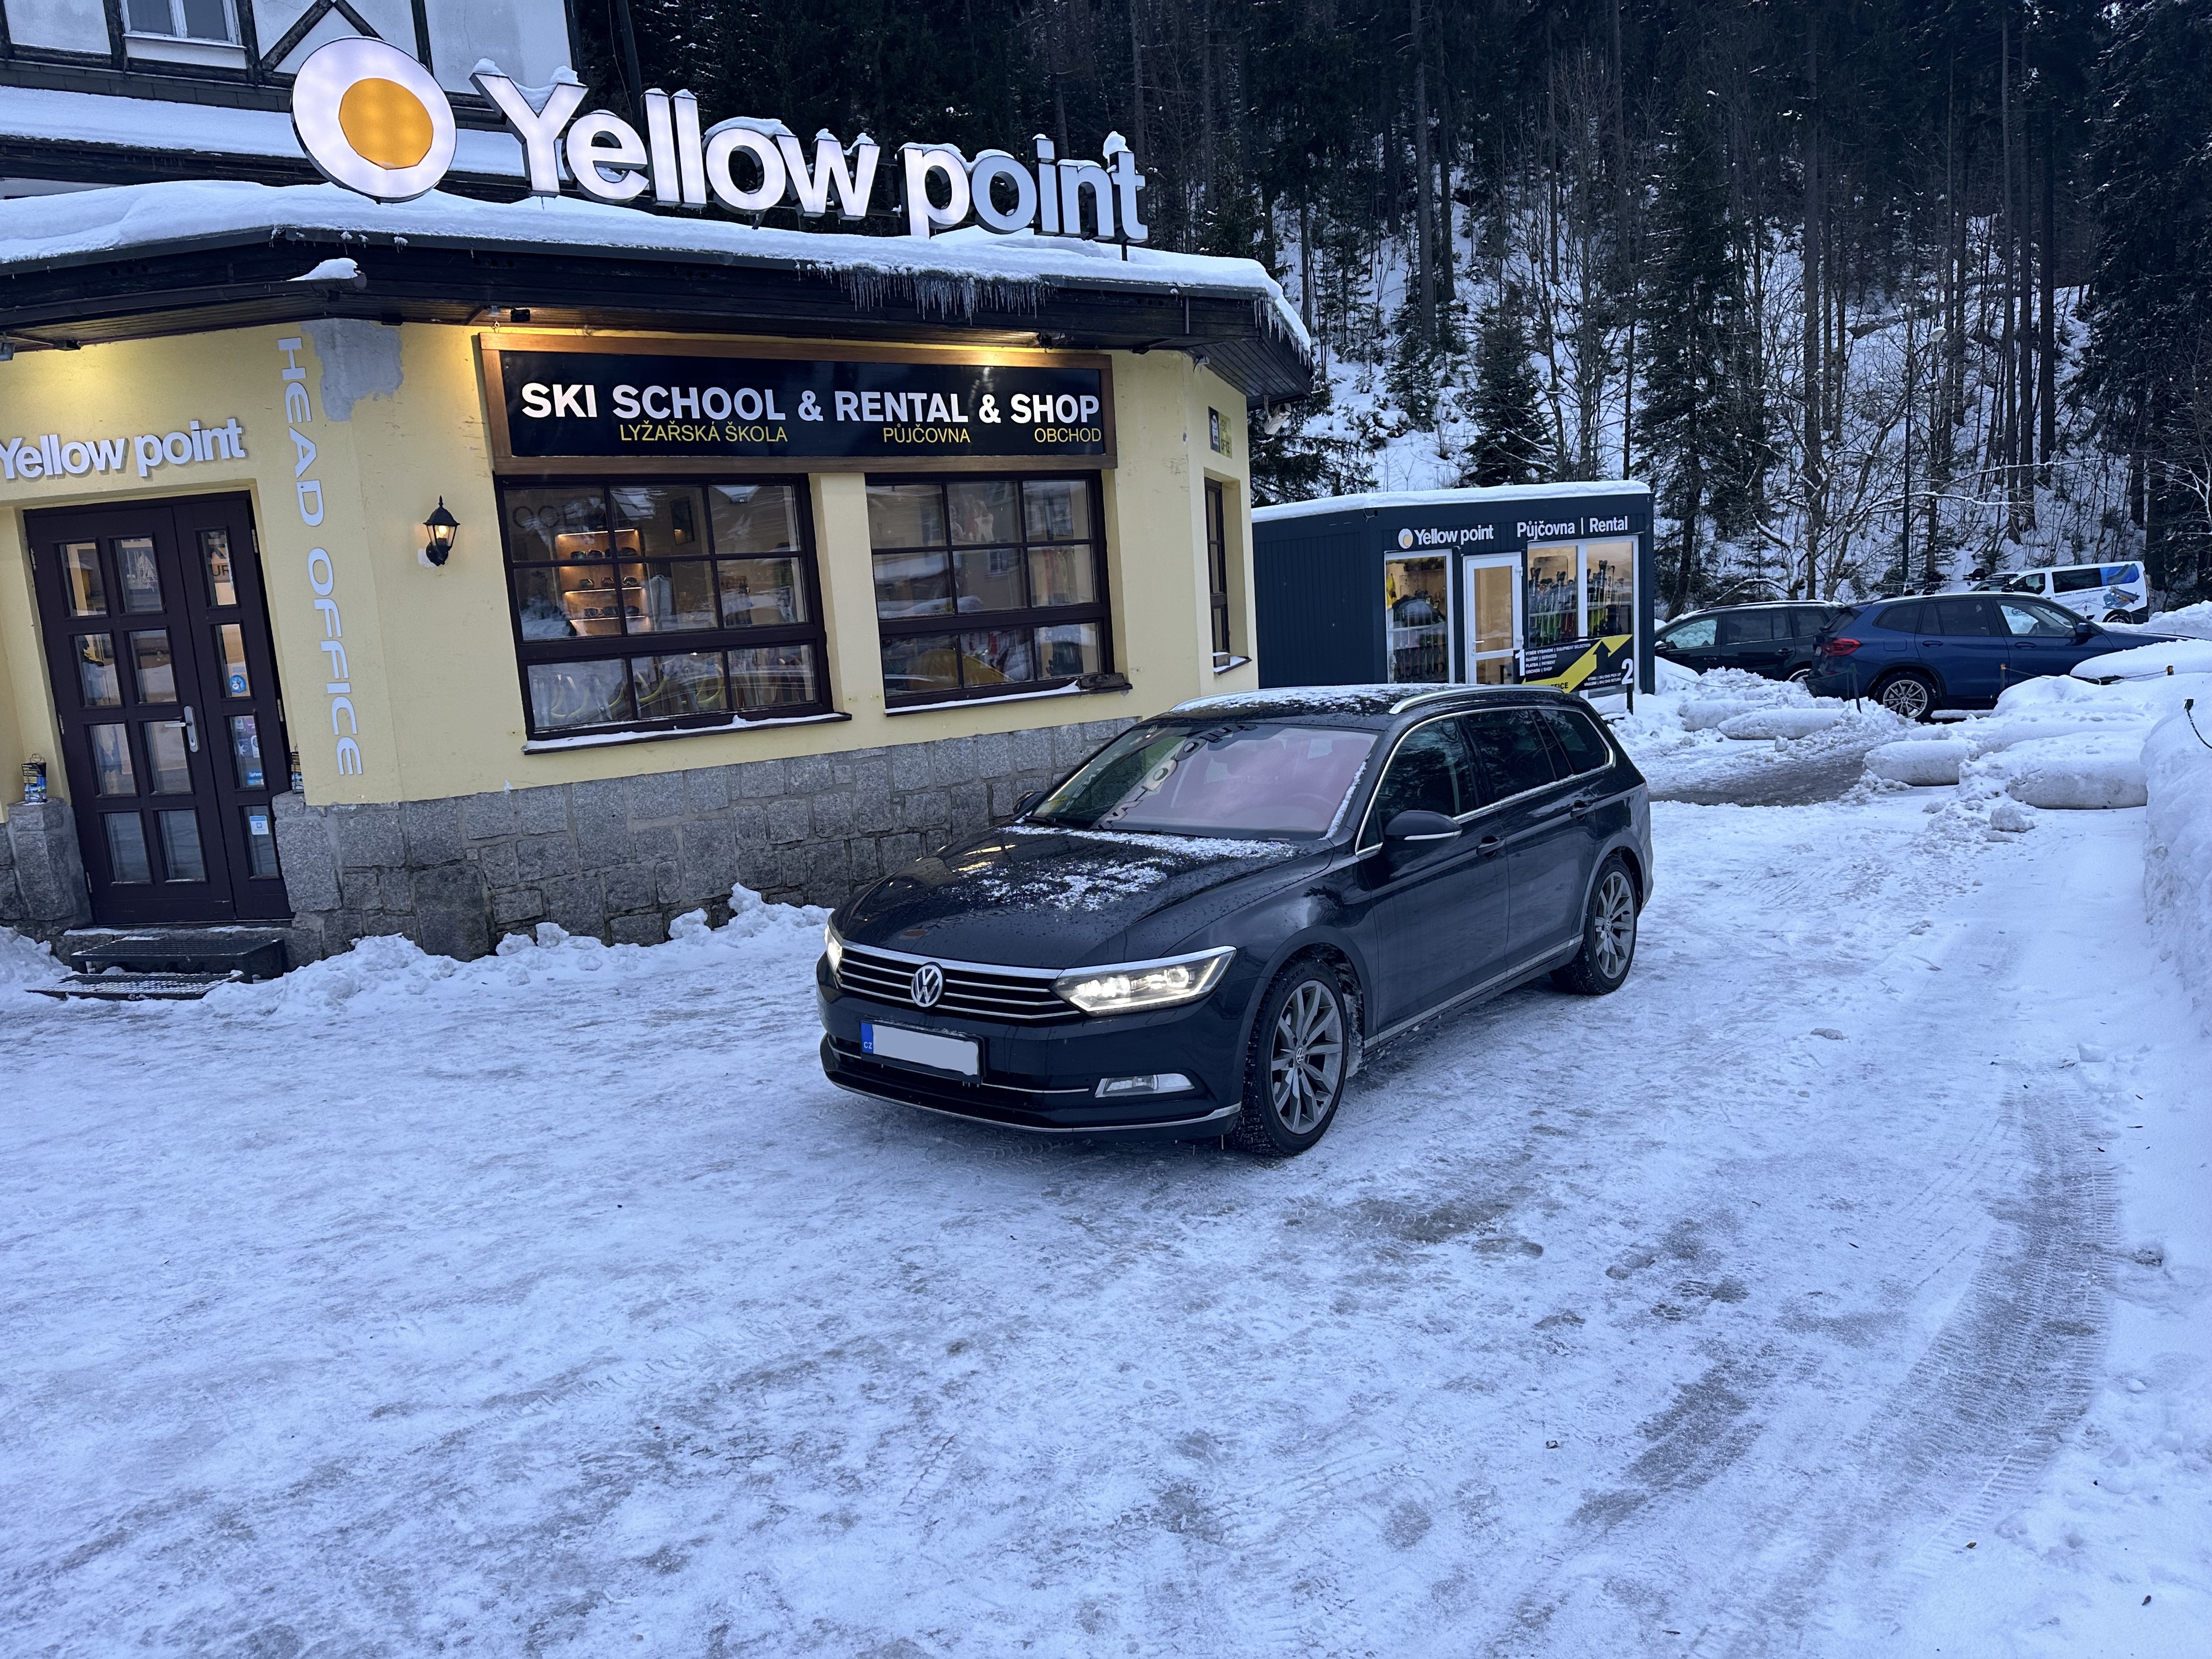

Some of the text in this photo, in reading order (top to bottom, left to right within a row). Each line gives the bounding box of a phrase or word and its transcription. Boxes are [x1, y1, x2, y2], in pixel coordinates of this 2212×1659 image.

[469, 71, 1148, 243] Yellow point
[521, 383, 1099, 424] SKI SCHOOL & RENTAL & SHOP
[620, 420, 787, 442] LYŽAŘSKÁ ŠKOLA
[883, 424, 971, 443] PŮJČOVNA
[1034, 427, 1102, 442] OBCHOD
[0, 418, 246, 479] Yellow point
[1414, 525, 1494, 545] Yellow point
[1517, 515, 1628, 540] Půjčovna Rental
[278, 337, 363, 776] HEAD OFFICE
[1515, 649, 1525, 676] 1
[1621, 658, 1633, 685] 2
[1282, 967, 1305, 993] NEXEN
